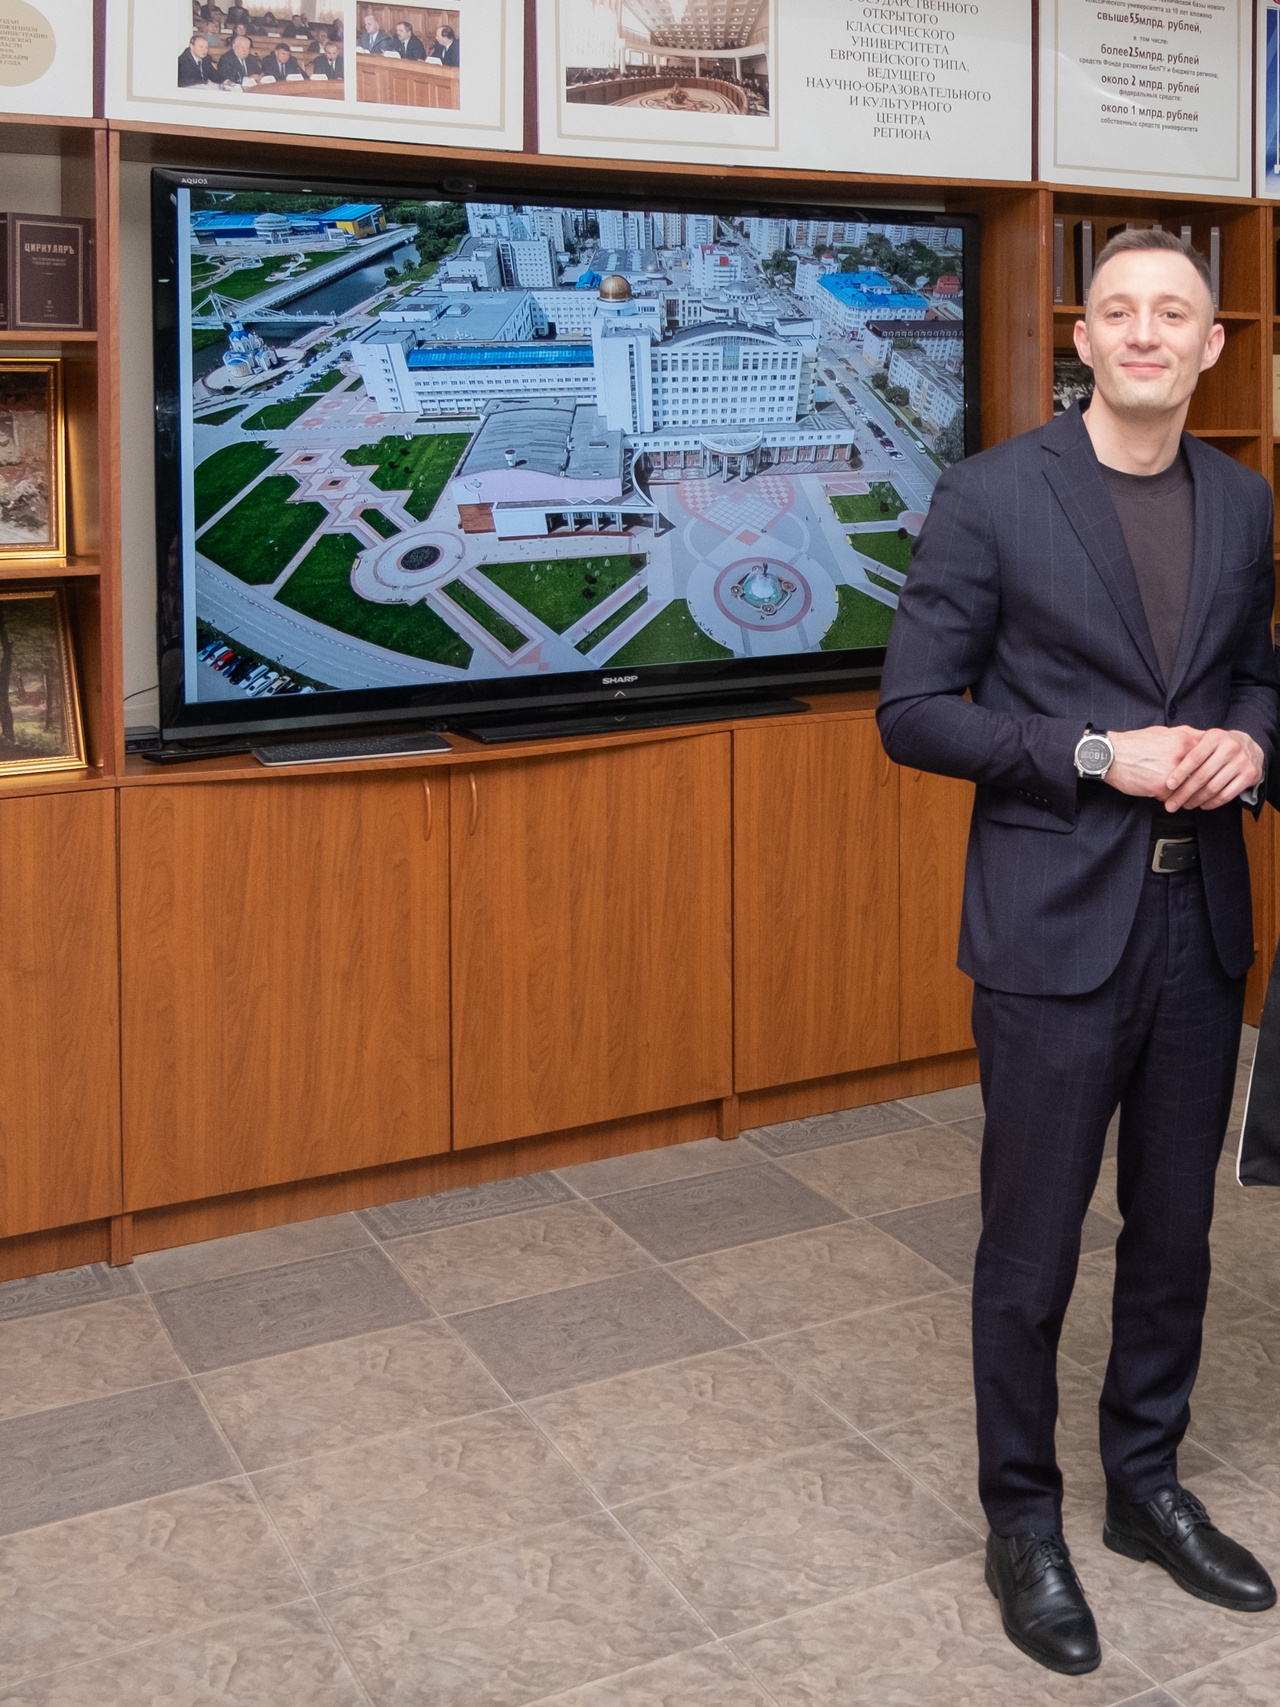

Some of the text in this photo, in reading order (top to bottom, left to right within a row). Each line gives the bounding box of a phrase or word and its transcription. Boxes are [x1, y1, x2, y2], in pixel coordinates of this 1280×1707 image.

[862, 7, 939, 25] ОТКРЫТОГО
[846, 20, 955, 41] КЛАССИЧЕСКОГО
[1167, 20, 1202, 34] рублей,
[851, 35, 950, 55] УНИВЕРСИТЕТА
[830, 49, 930, 68] ЕВРОПЕЙСКОГО
[1167, 52, 1200, 65] рублей
[867, 66, 936, 83] ВЕДУЩЕГО
[1101, 73, 1200, 94] около 2 млрд. рублей
[806, 76, 992, 102] НАУЧНО-ОБРАЗОВАТЕЛЬНОГО
[849, 95, 952, 113] И КУЛЬТУРНОГО
[1101, 103, 1199, 122] около 1 млрд. рублей
[876, 112, 926, 126] ЦЕНТРА
[873, 126, 931, 141] РЕГИОНА
[602, 675, 638, 685] SHARP
